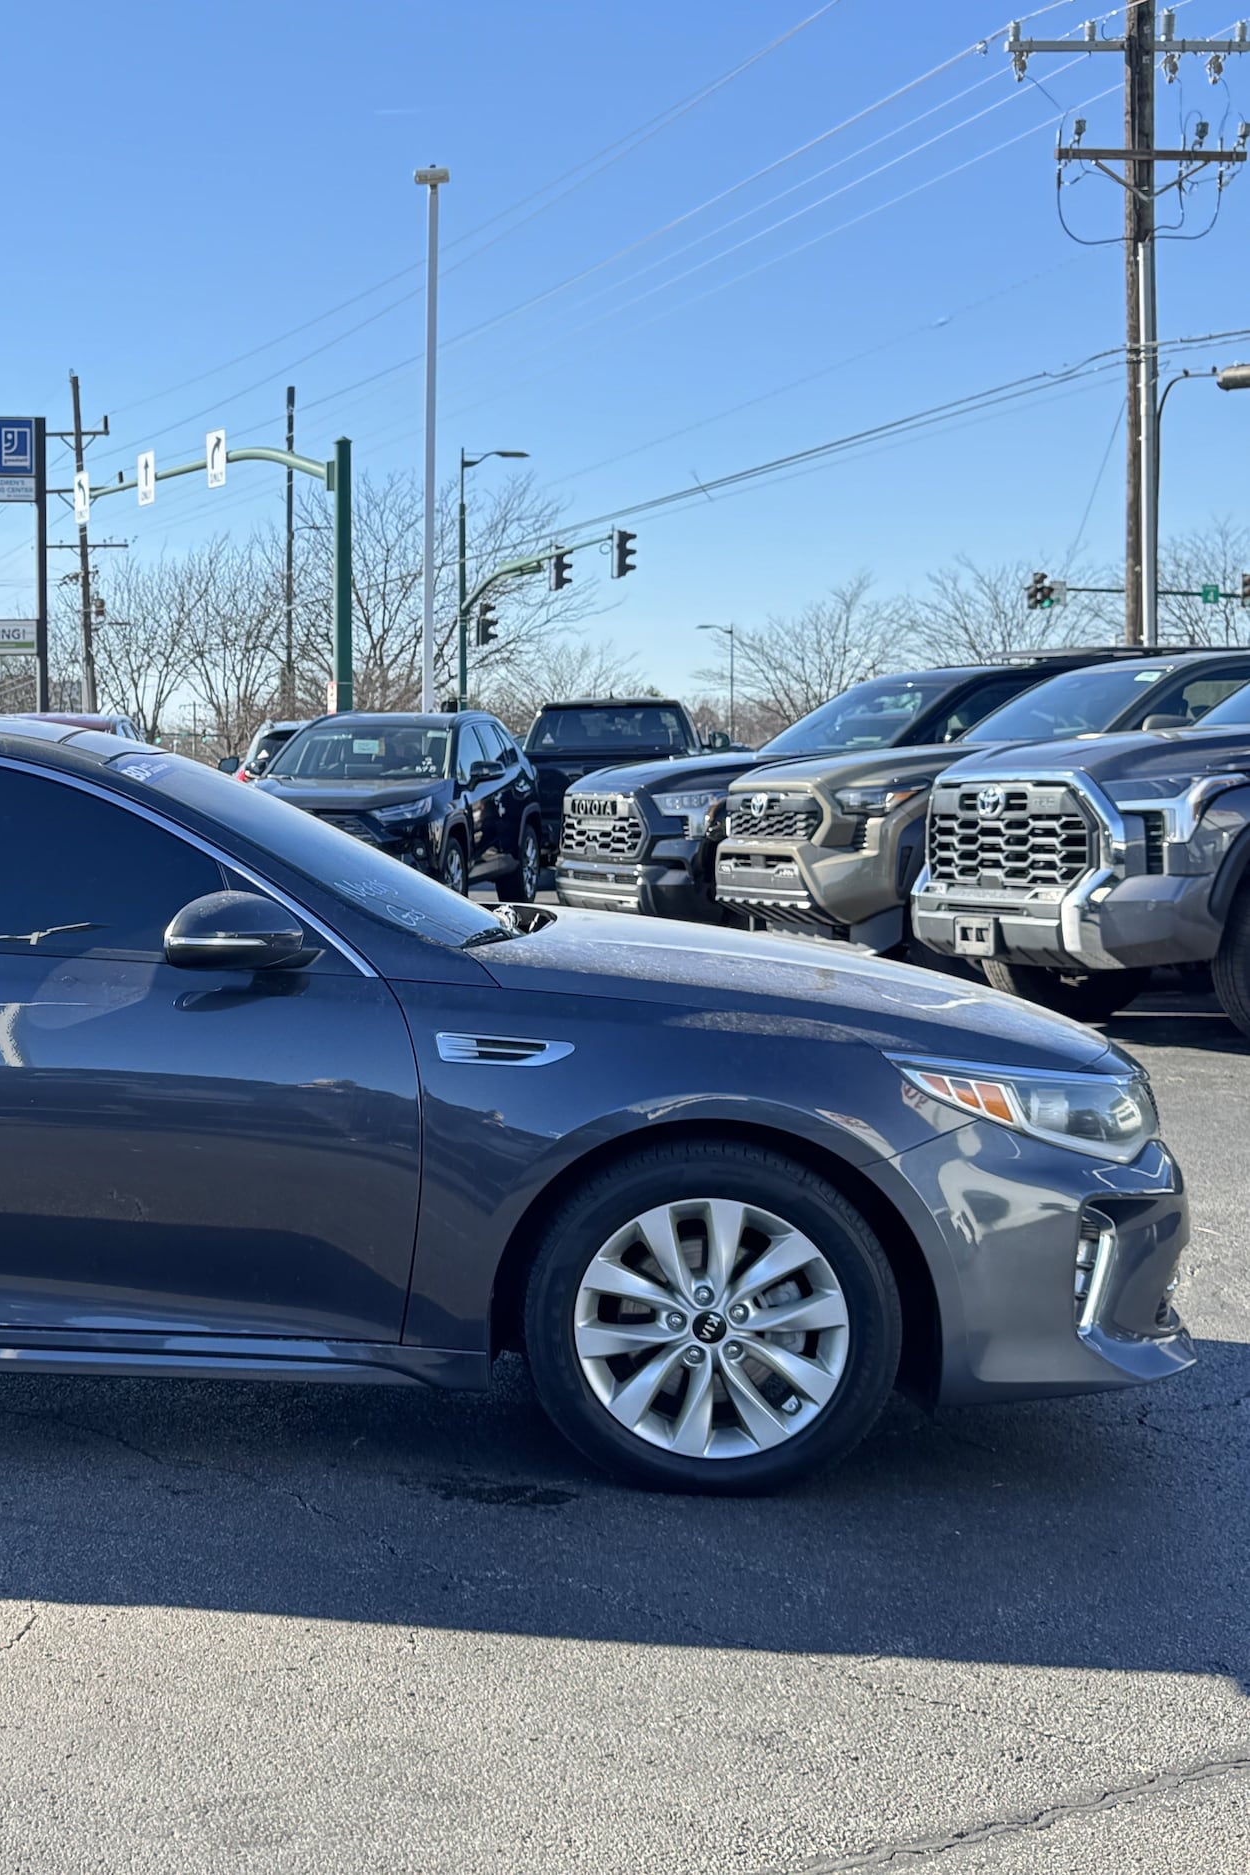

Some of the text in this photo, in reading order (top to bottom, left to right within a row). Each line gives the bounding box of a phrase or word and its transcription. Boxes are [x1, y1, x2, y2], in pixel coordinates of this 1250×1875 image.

[7, 486, 33, 494] CENTER
[574, 800, 613, 816] TOYOTA
[699, 1314, 721, 1340] KIA
